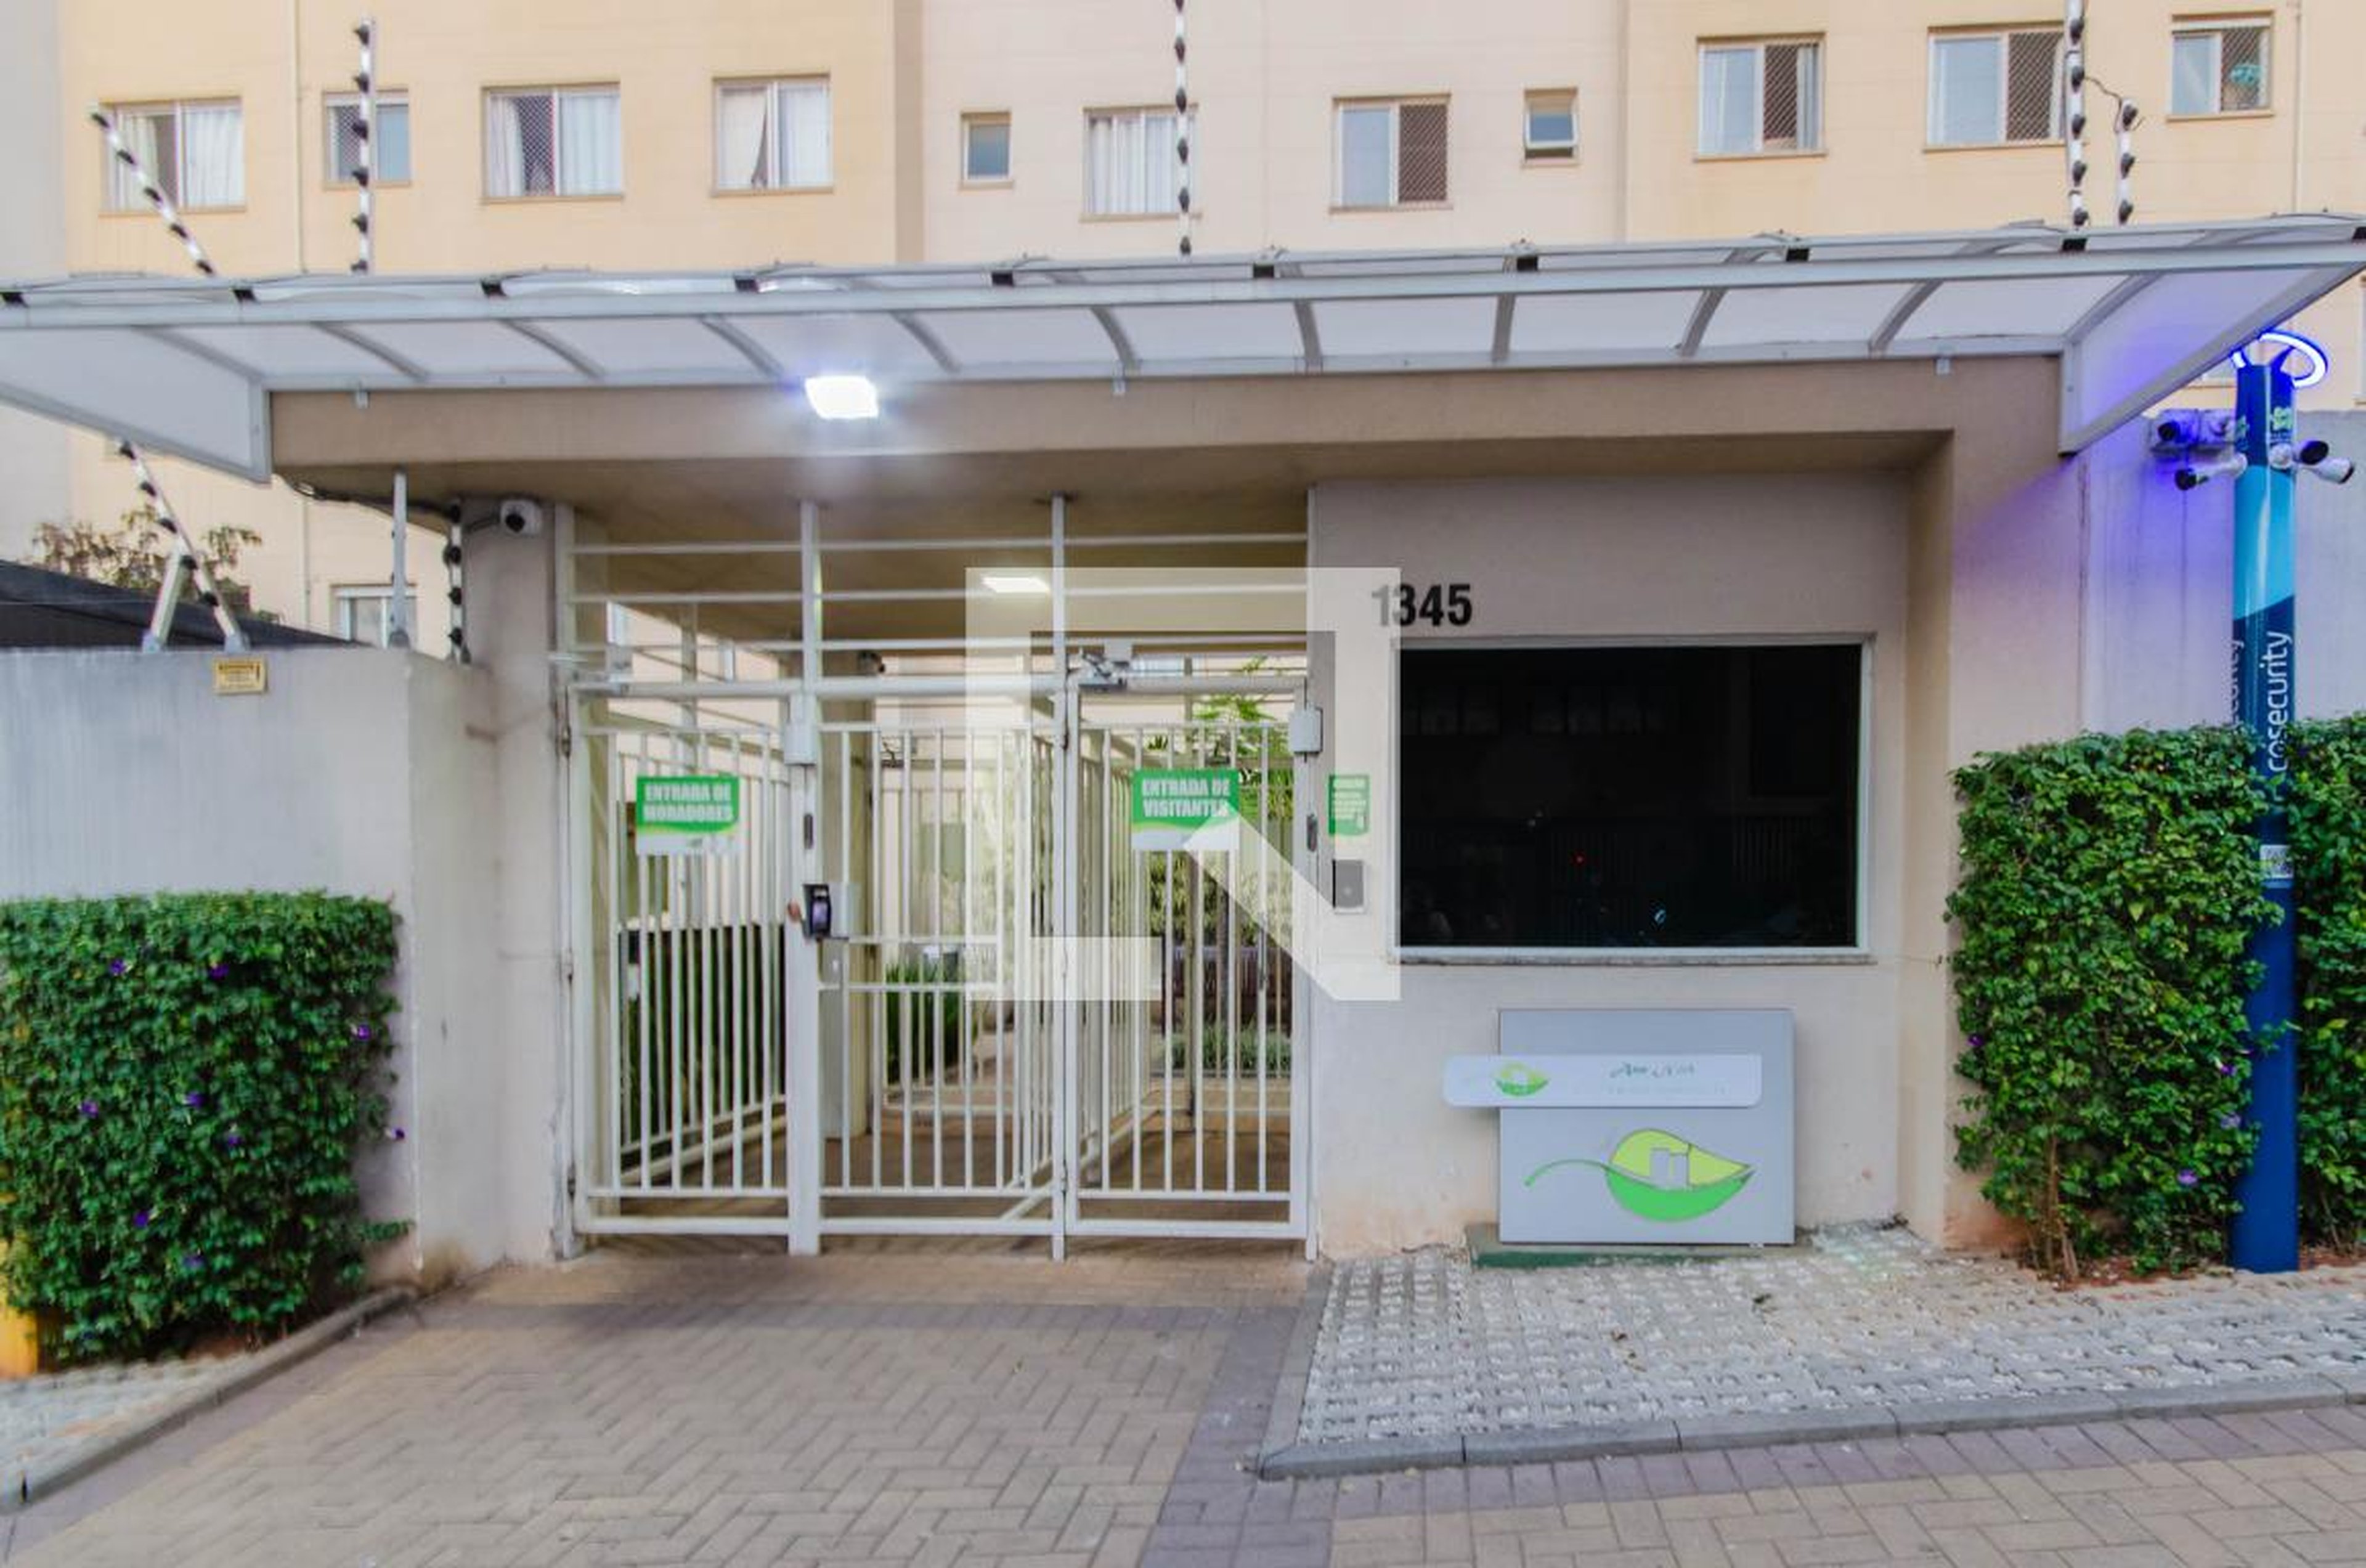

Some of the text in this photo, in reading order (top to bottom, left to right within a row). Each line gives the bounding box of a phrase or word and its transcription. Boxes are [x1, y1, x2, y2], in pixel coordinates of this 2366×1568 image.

[1372, 584, 1472, 627] 1345
[644, 782, 732, 801] ENTRADA DE
[1142, 779, 1230, 796] ENTRADA DE
[643, 804, 733, 822] MORADORES
